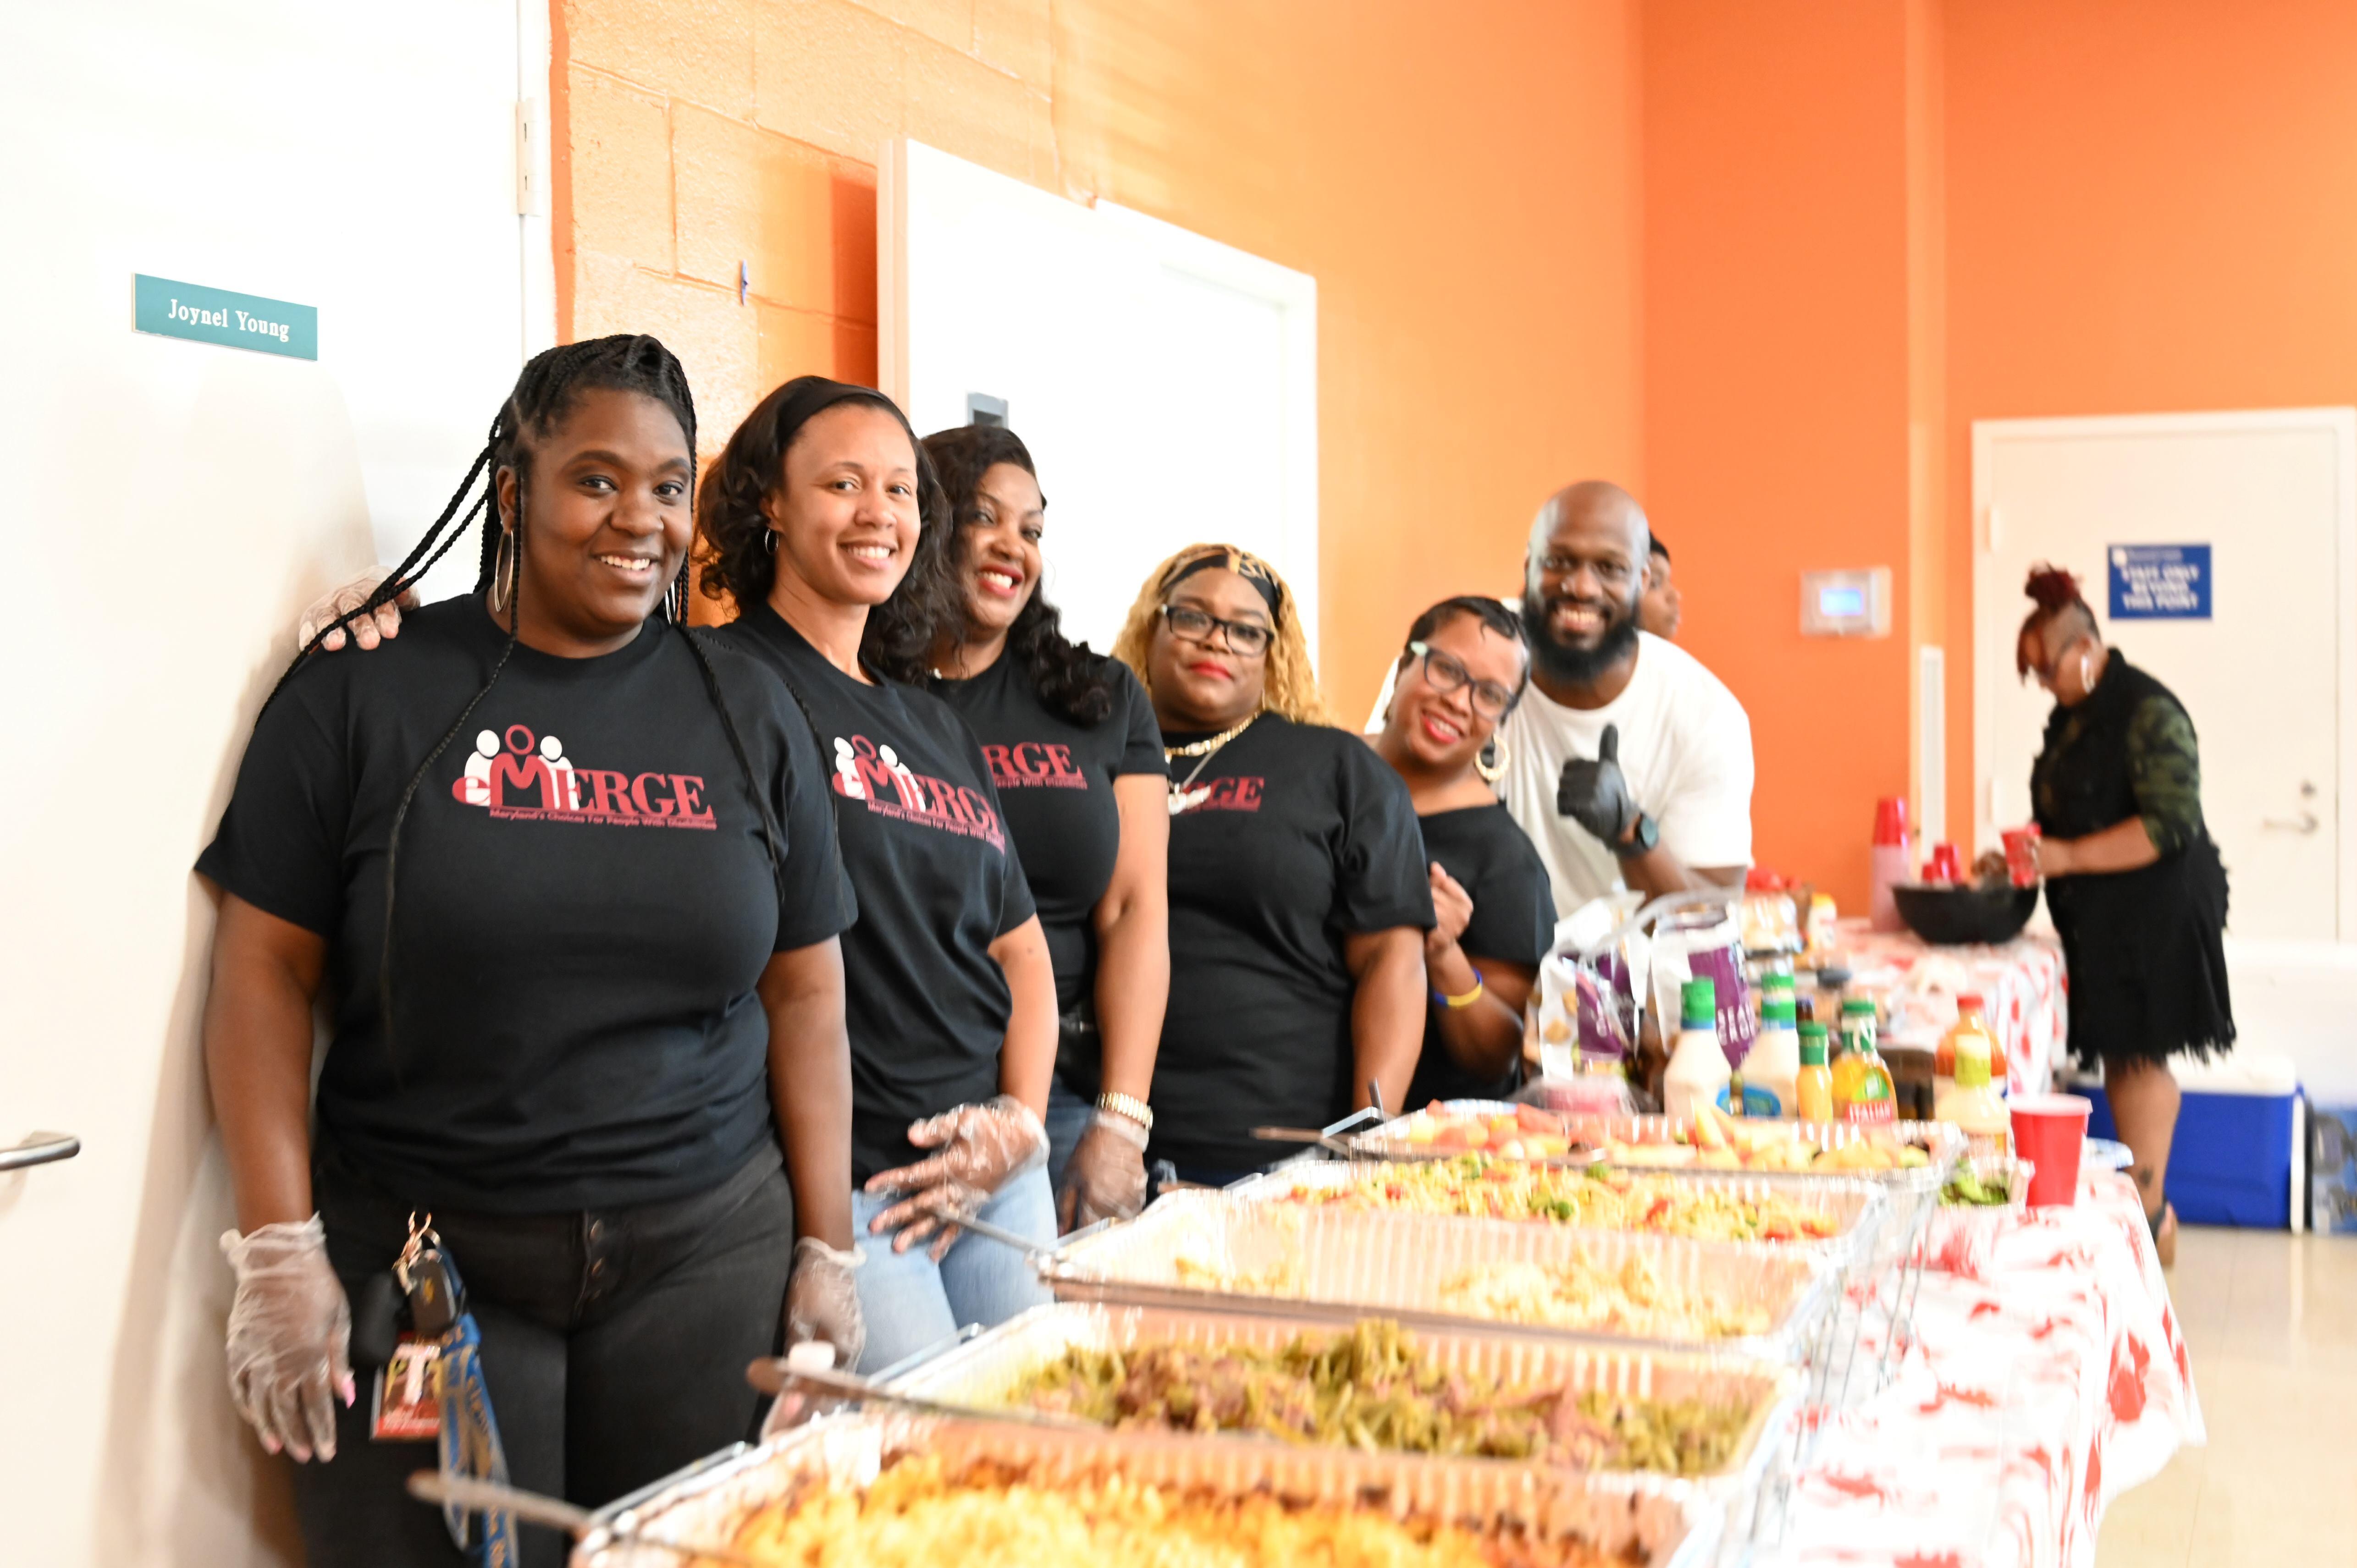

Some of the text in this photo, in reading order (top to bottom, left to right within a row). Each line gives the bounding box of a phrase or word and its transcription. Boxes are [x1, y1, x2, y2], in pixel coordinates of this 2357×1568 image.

[169, 299, 289, 342] Joynel Young
[1849, 1101, 1891, 1123] ITALIAN
